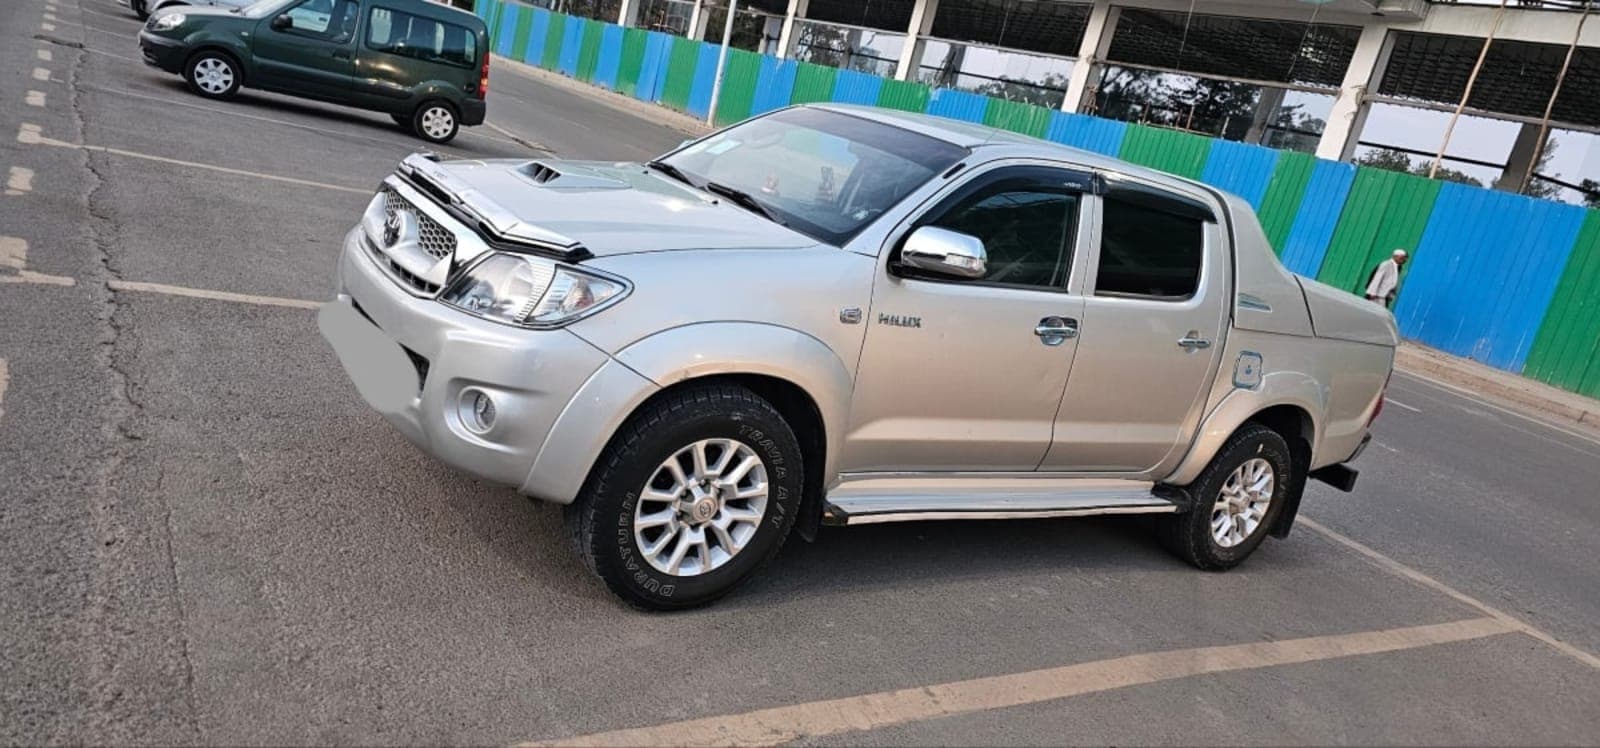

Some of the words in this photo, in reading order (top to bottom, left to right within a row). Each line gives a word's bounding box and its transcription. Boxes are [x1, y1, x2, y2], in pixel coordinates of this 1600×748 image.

[878, 312, 922, 328] HILUX
[739, 424, 787, 479] TRAVIA
[771, 485, 789, 529] A/T
